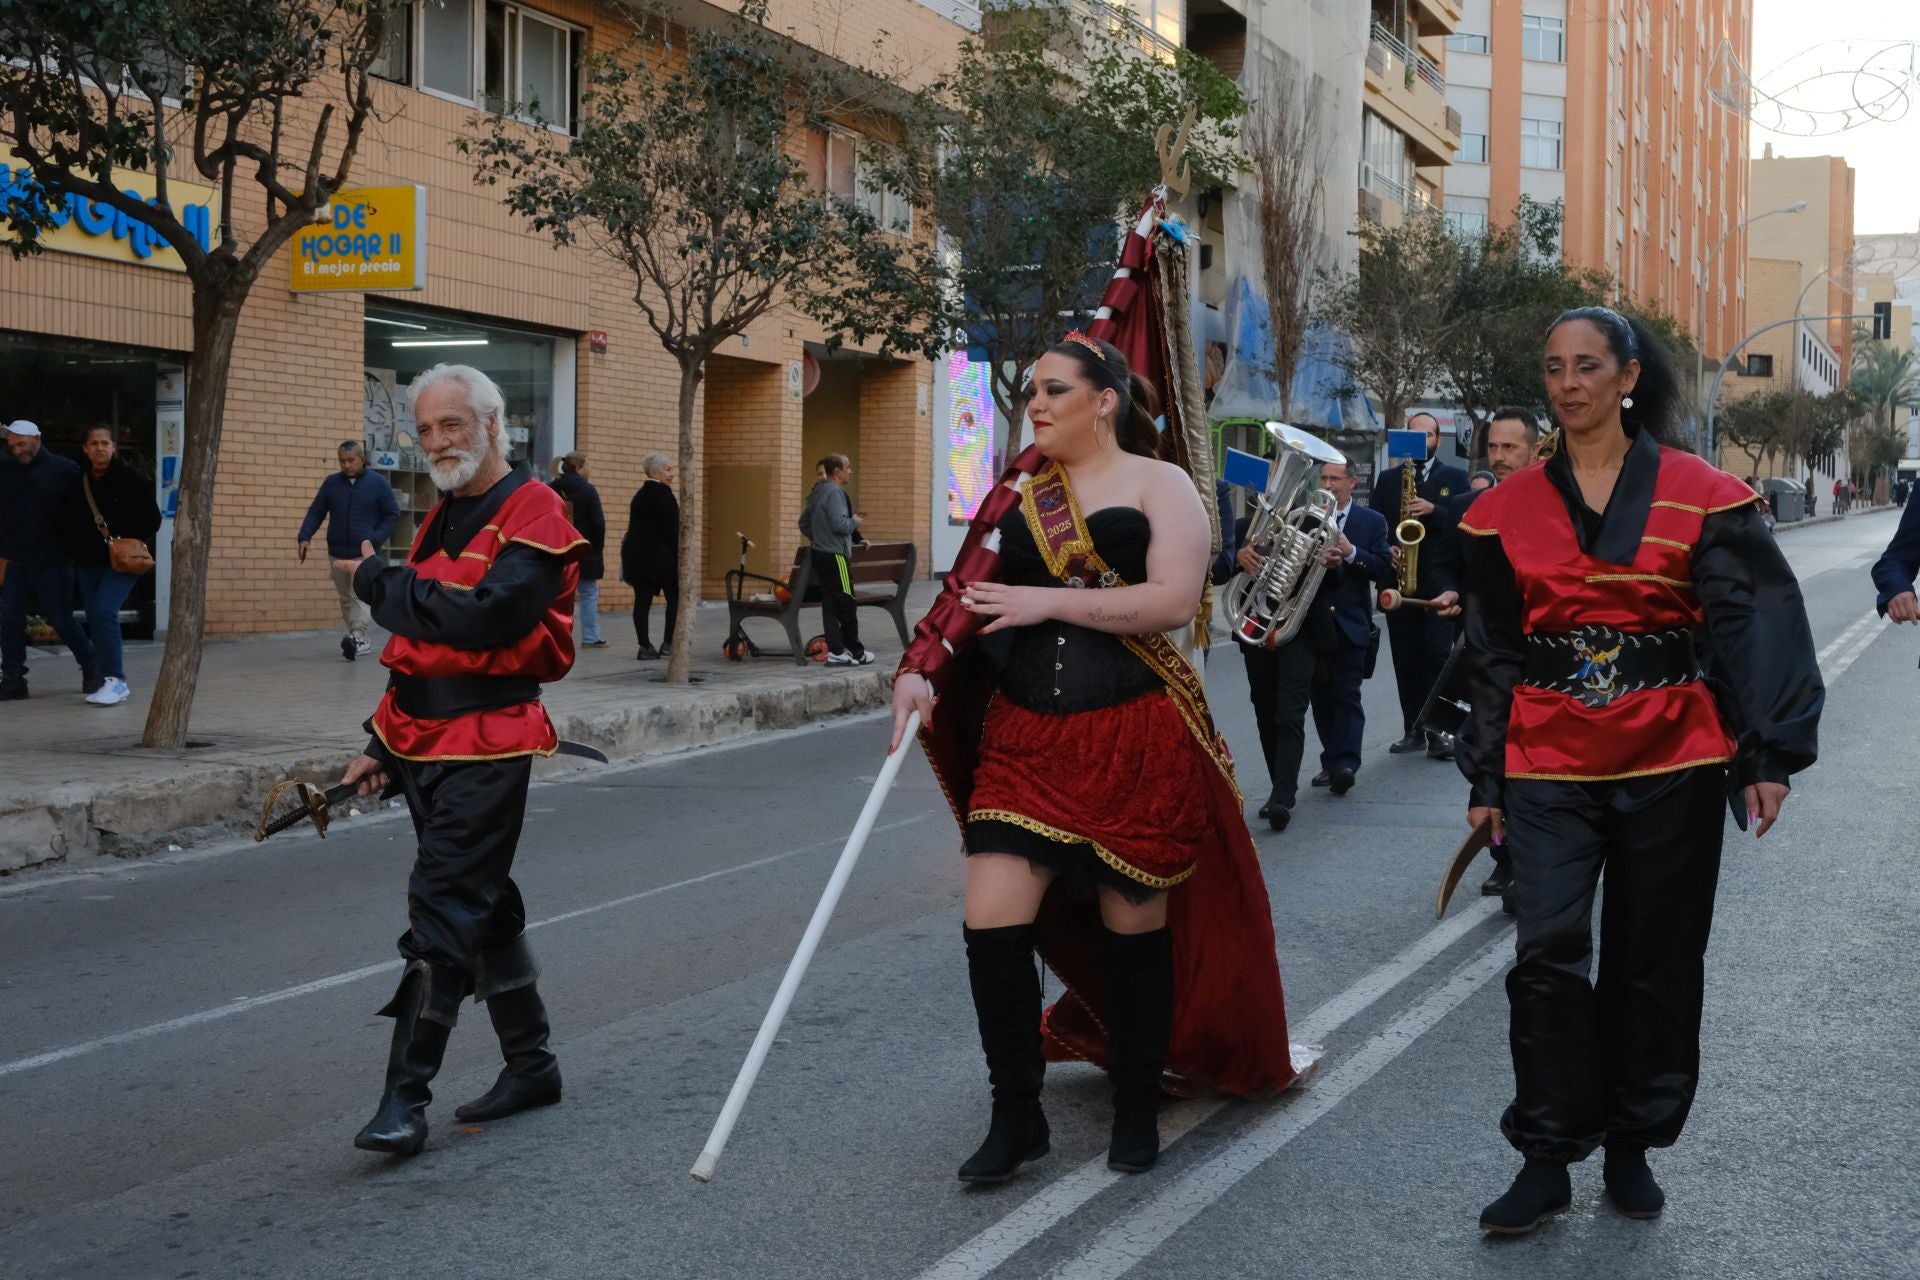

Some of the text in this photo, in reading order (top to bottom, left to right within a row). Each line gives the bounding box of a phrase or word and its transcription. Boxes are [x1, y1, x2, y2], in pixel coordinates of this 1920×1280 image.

[333, 204, 366, 229] DE
[301, 232, 401, 263] HOGAR II
[304, 258, 400, 277] El mejor precio
[1047, 520, 1072, 538] 2025
